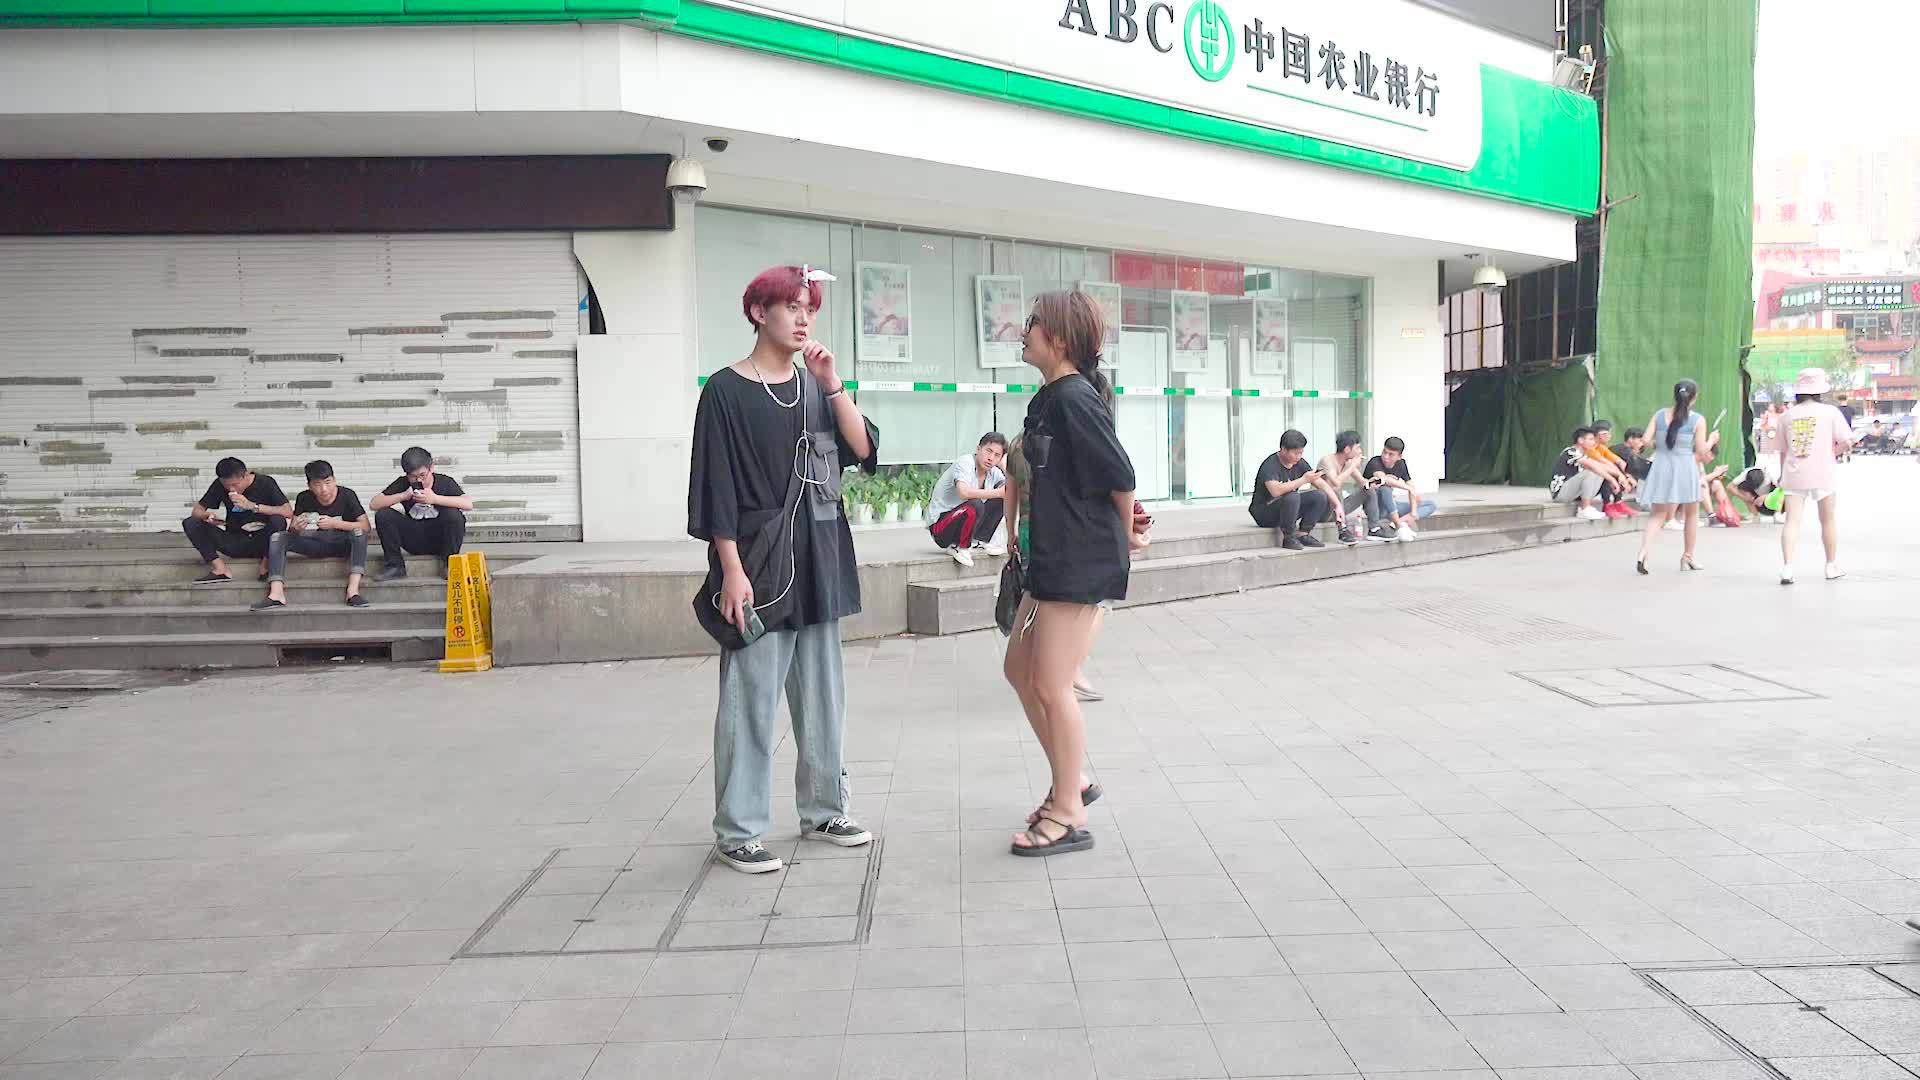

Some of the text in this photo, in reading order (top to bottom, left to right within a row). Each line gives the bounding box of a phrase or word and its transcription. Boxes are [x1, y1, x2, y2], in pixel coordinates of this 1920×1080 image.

[1059, 0, 1440, 117] ABC 中国农业银行
